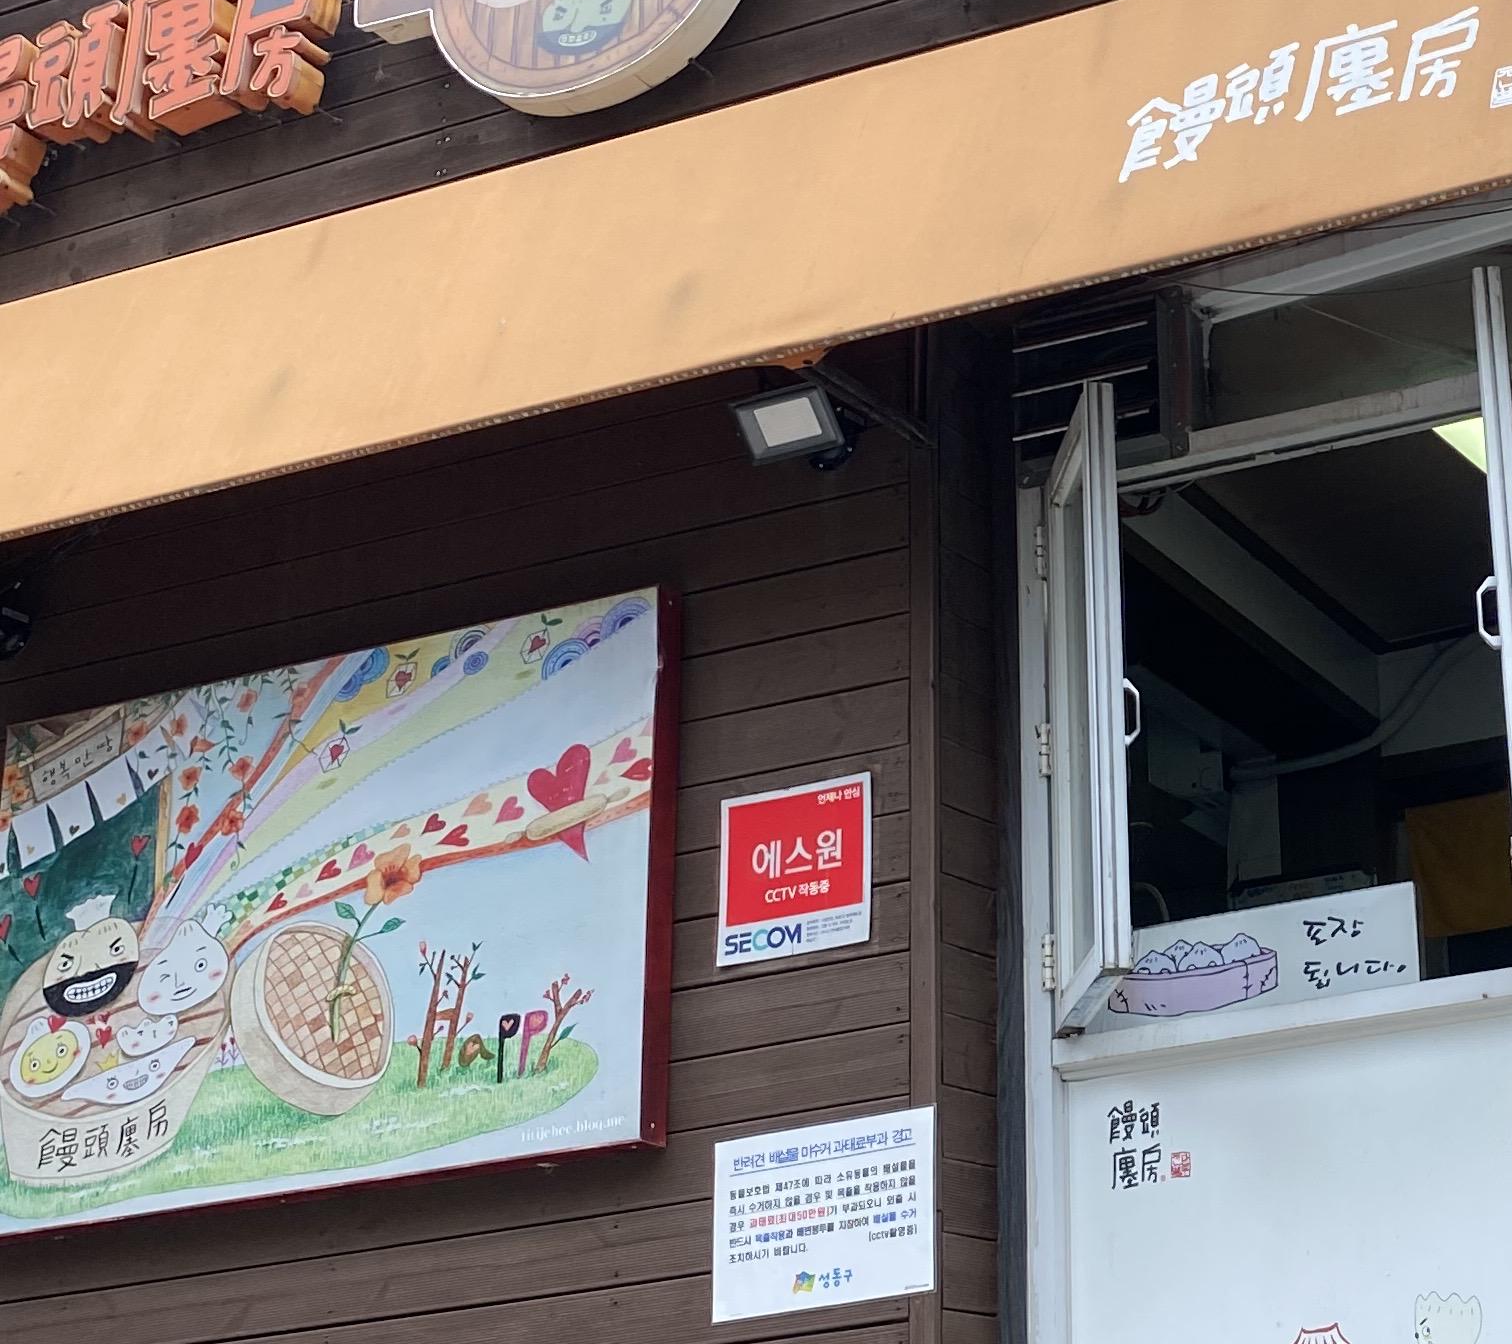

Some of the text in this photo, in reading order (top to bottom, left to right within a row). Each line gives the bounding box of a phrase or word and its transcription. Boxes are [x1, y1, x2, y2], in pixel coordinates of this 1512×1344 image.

[818, 791, 842, 805] 언제나
[752, 828, 843, 879] 에스원
[765, 879, 830, 904] CCTV 작동중
[725, 922, 802, 956] SECOM
[733, 1152, 765, 1171] 반려견
[801, 1141, 831, 1158] 미수거
[892, 1128, 913, 1144] 경고
[729, 1221, 744, 1234] 경우
[908, 1191, 916, 1202] 시
[805, 1191, 821, 1204] 경우
[729, 1234, 751, 1248] 반드시
[900, 1208, 917, 1220] 수거
[818, 1268, 853, 1288] 성동구
